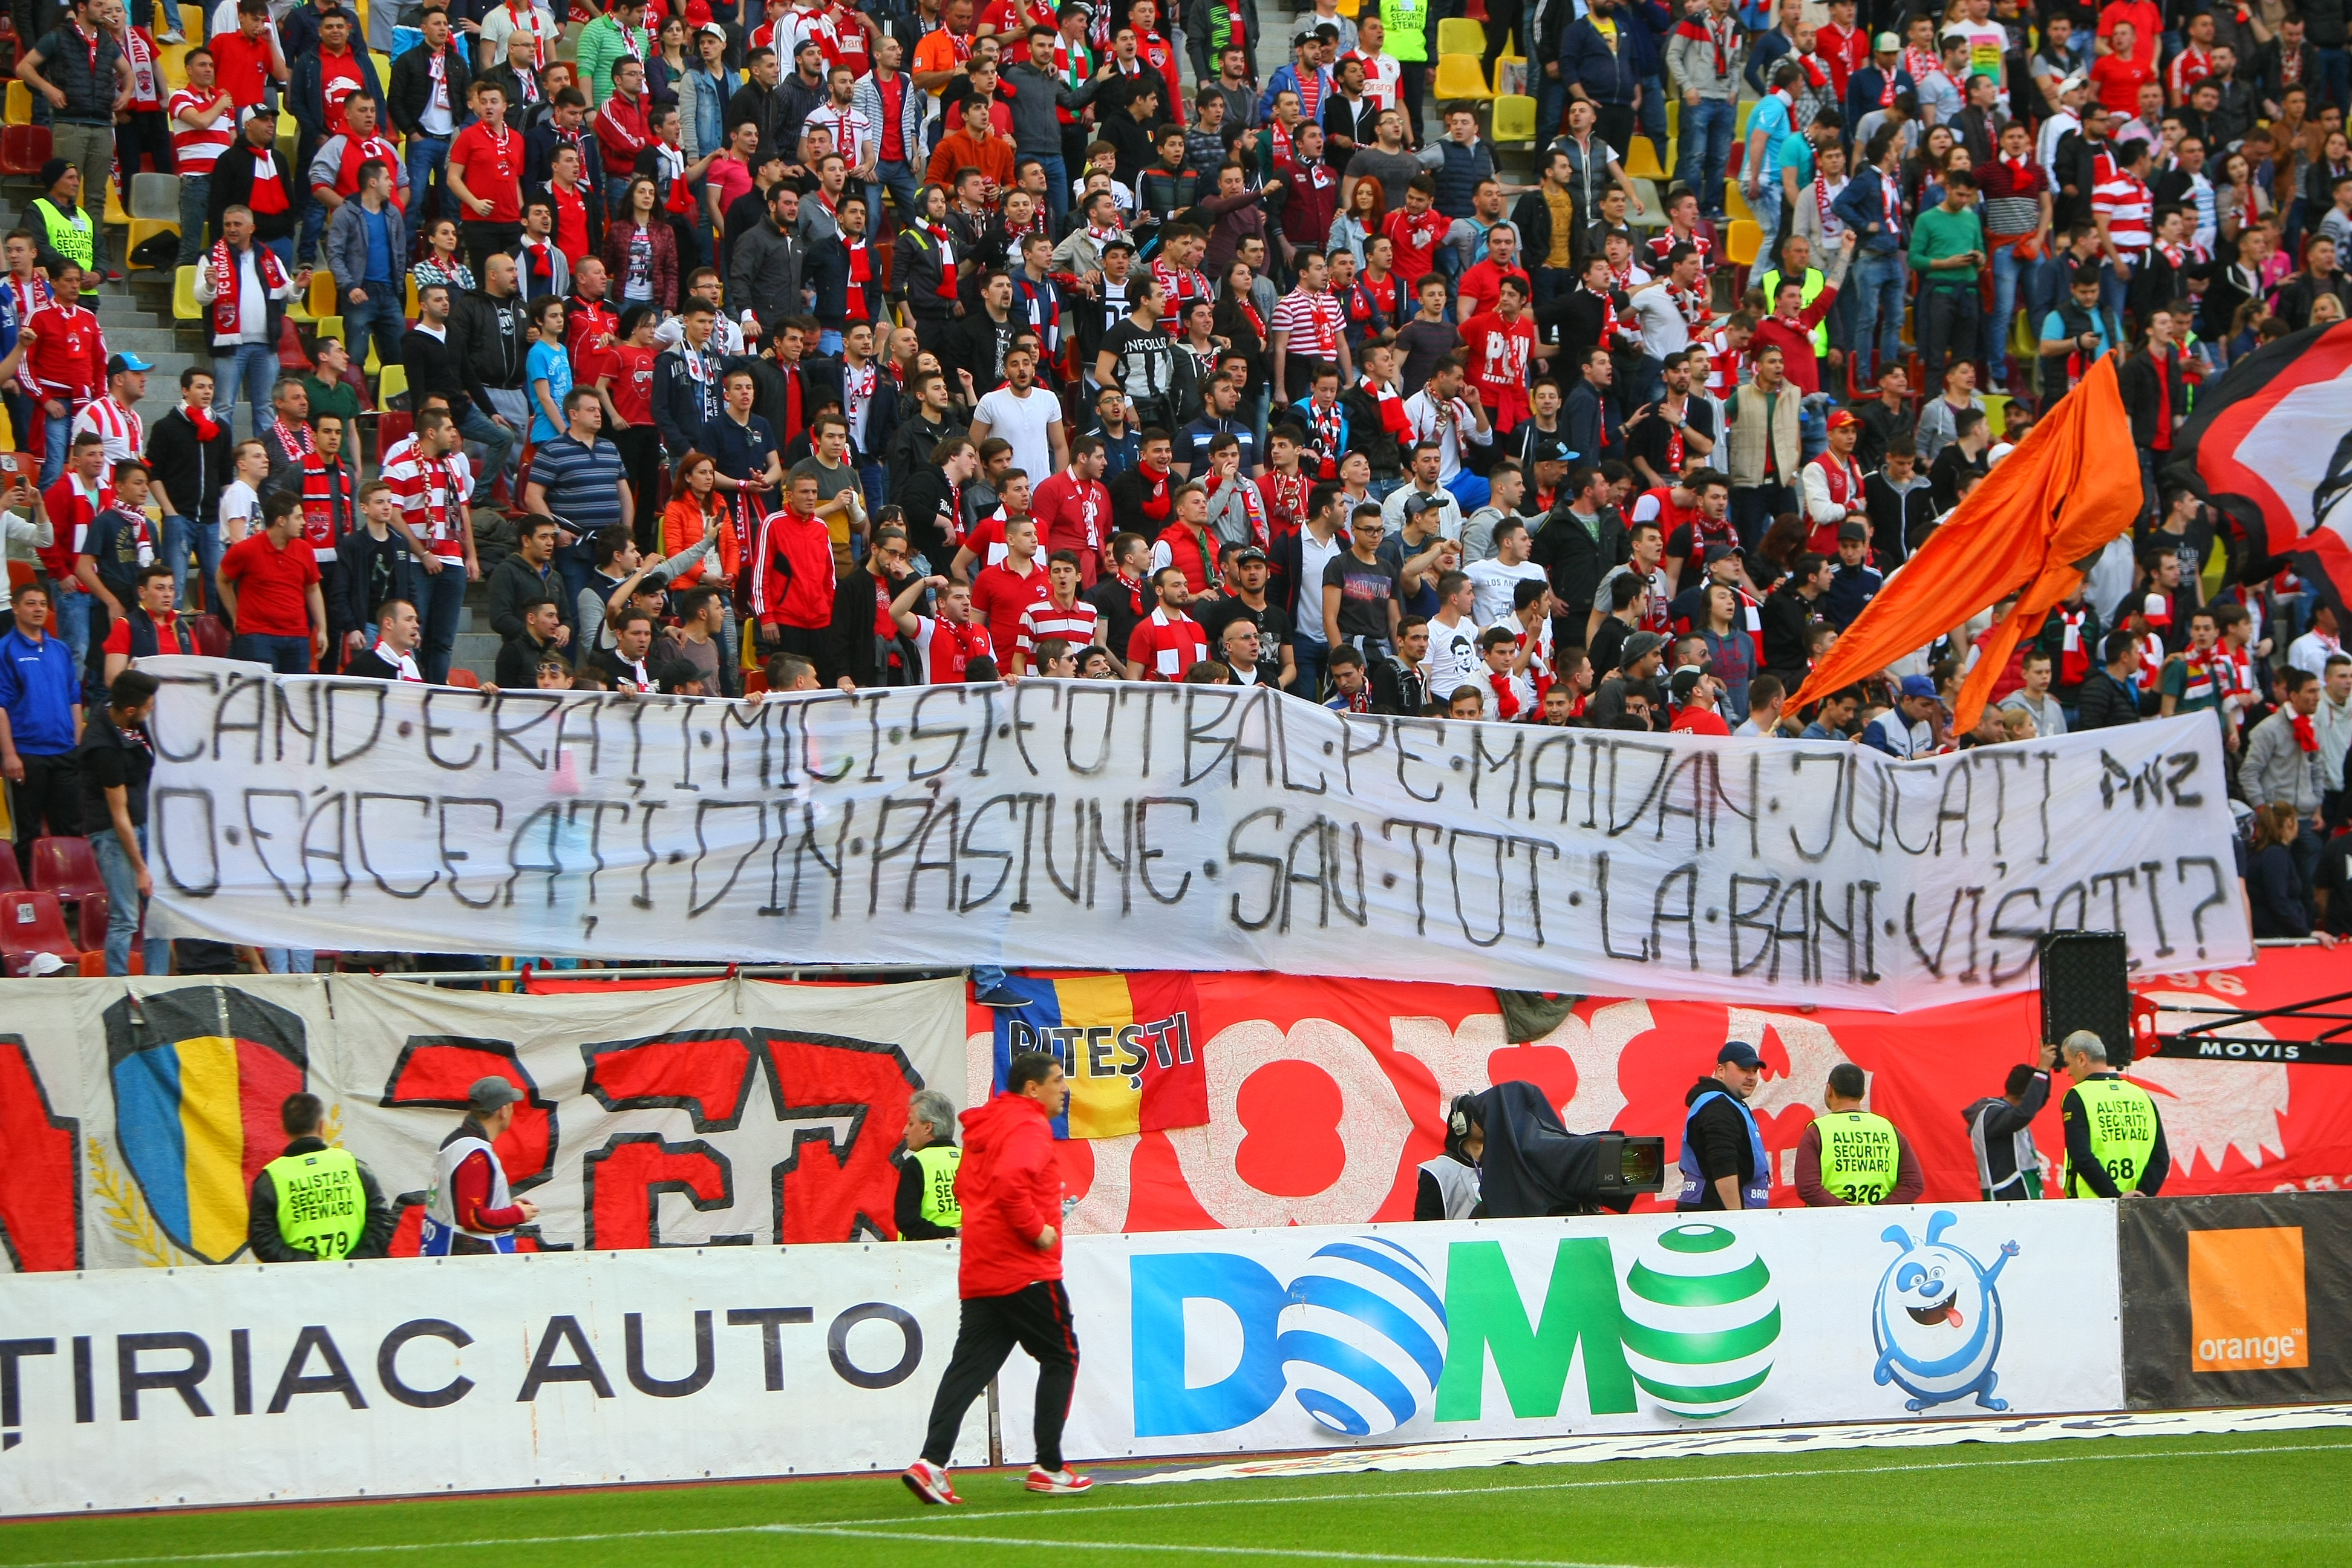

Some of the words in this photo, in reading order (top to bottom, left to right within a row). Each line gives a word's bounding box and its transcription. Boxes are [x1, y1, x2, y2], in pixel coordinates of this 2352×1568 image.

[1597, 850, 1700, 971] LA
[1728, 871, 1882, 986] BANI
[2198, 1041, 2299, 1059] MOVIS
[2097, 1100, 2147, 1114] ALISTAR
[1833, 1131, 1890, 1145] ALISTAR
[1834, 1145, 1890, 1159] SECURITY
[1835, 1158, 1890, 1172] STEWARD
[289, 1170, 351, 1195] ALISTAR
[290, 1186, 353, 1210] SECURITY
[1843, 1184, 1882, 1205] 326
[293, 1201, 354, 1223] STEWARD
[304, 1231, 348, 1256] 379
[515, 1301, 924, 1402] AUTO
[2198, 1334, 2296, 1365] orange
